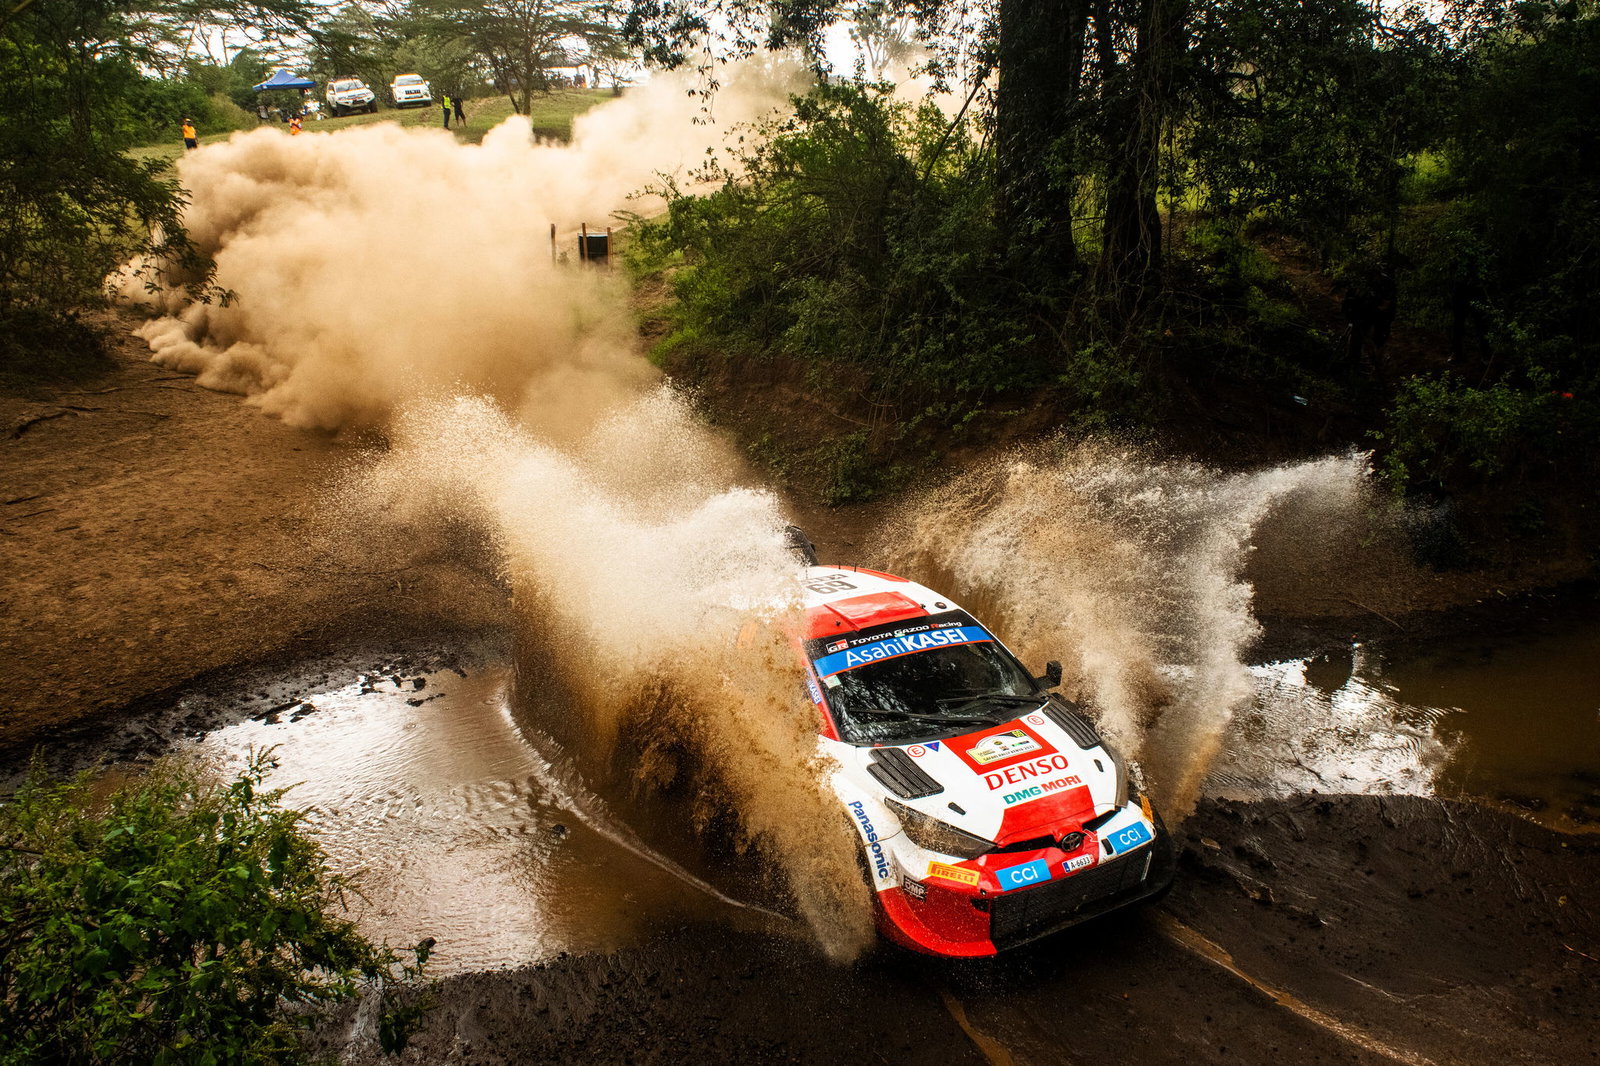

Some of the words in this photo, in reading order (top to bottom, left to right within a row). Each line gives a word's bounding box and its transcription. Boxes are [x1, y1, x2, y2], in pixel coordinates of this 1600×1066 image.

[806, 581, 858, 594] 69
[850, 632, 893, 645] TOYOTA
[894, 625, 930, 636] GAZOO
[930, 621, 963, 629] Racing
[984, 755, 1069, 791] DENSO
[1003, 786, 1042, 805] DMG
[1041, 775, 1082, 792] MORI
[848, 800, 888, 879] Panasonic
[931, 864, 976, 883] PIRELLI
[1070, 857, 1091, 869] A-6633
[905, 881, 924, 896] OMP
